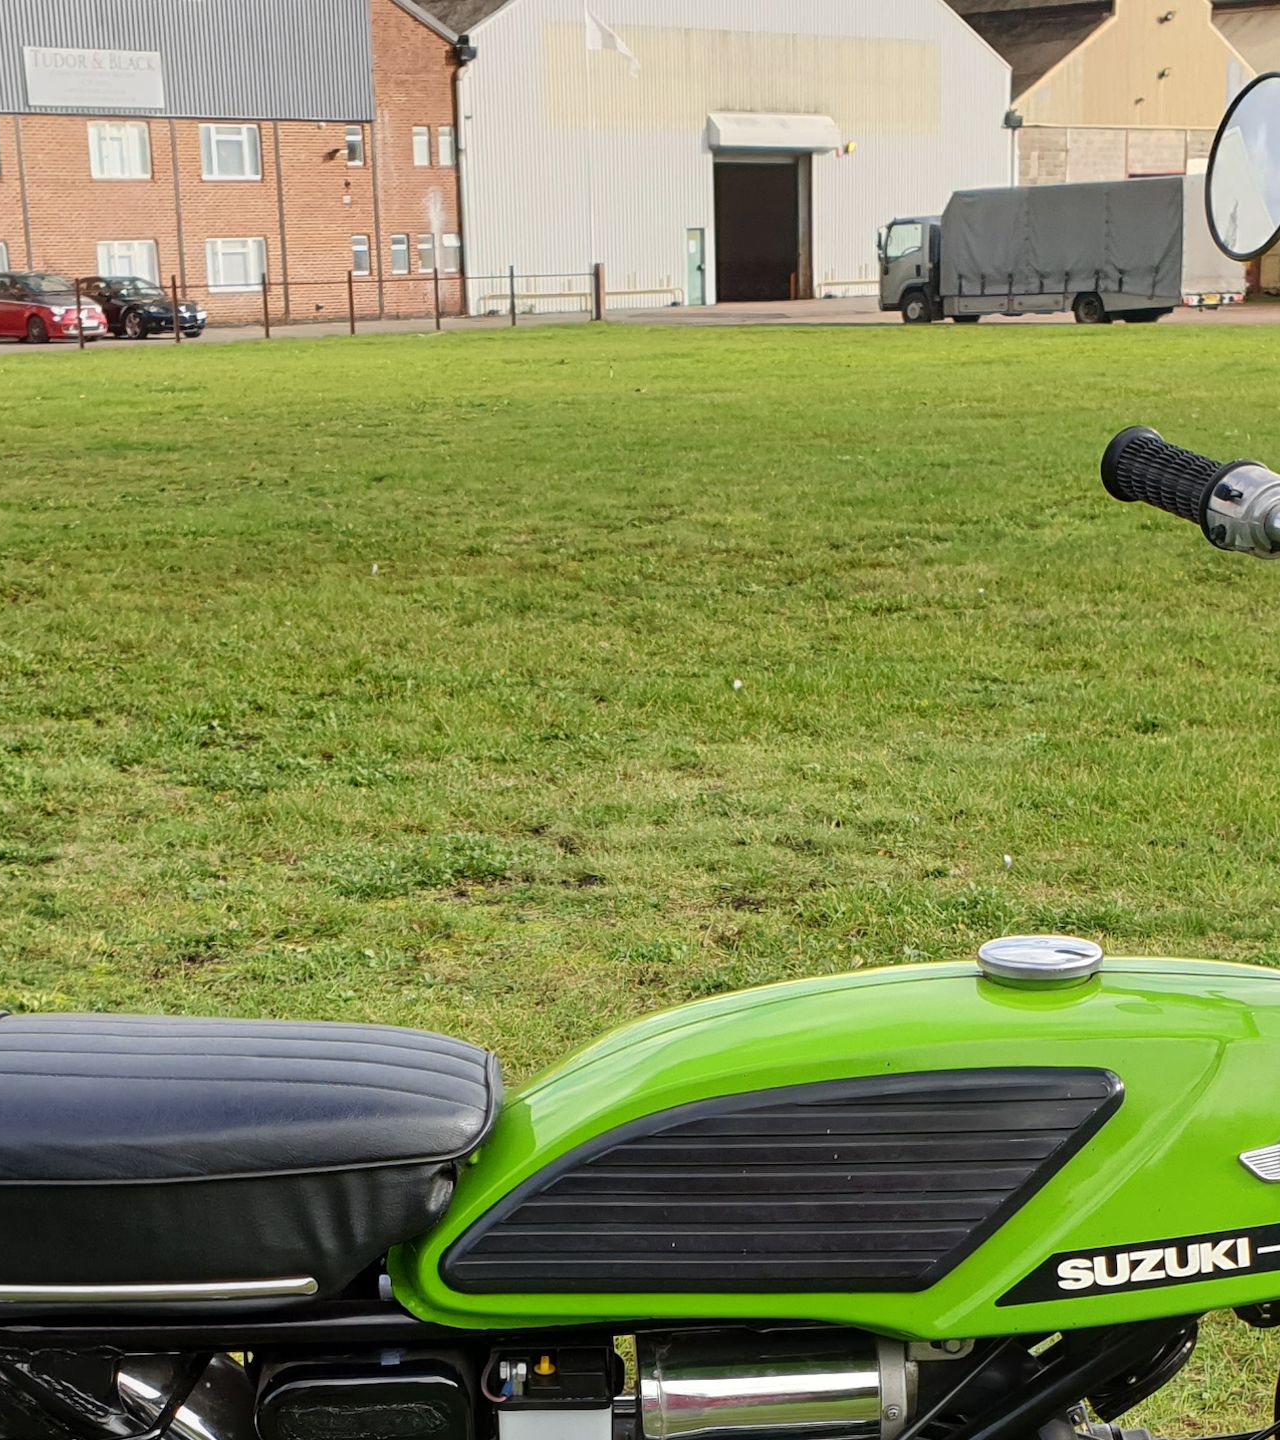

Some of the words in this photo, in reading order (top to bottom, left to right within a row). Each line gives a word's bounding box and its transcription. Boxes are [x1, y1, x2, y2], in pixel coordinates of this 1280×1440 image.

[30, 50, 88, 69] TUDOR
[109, 53, 156, 71] BLACK
[1057, 1237, 1251, 1290] SUZUKI
